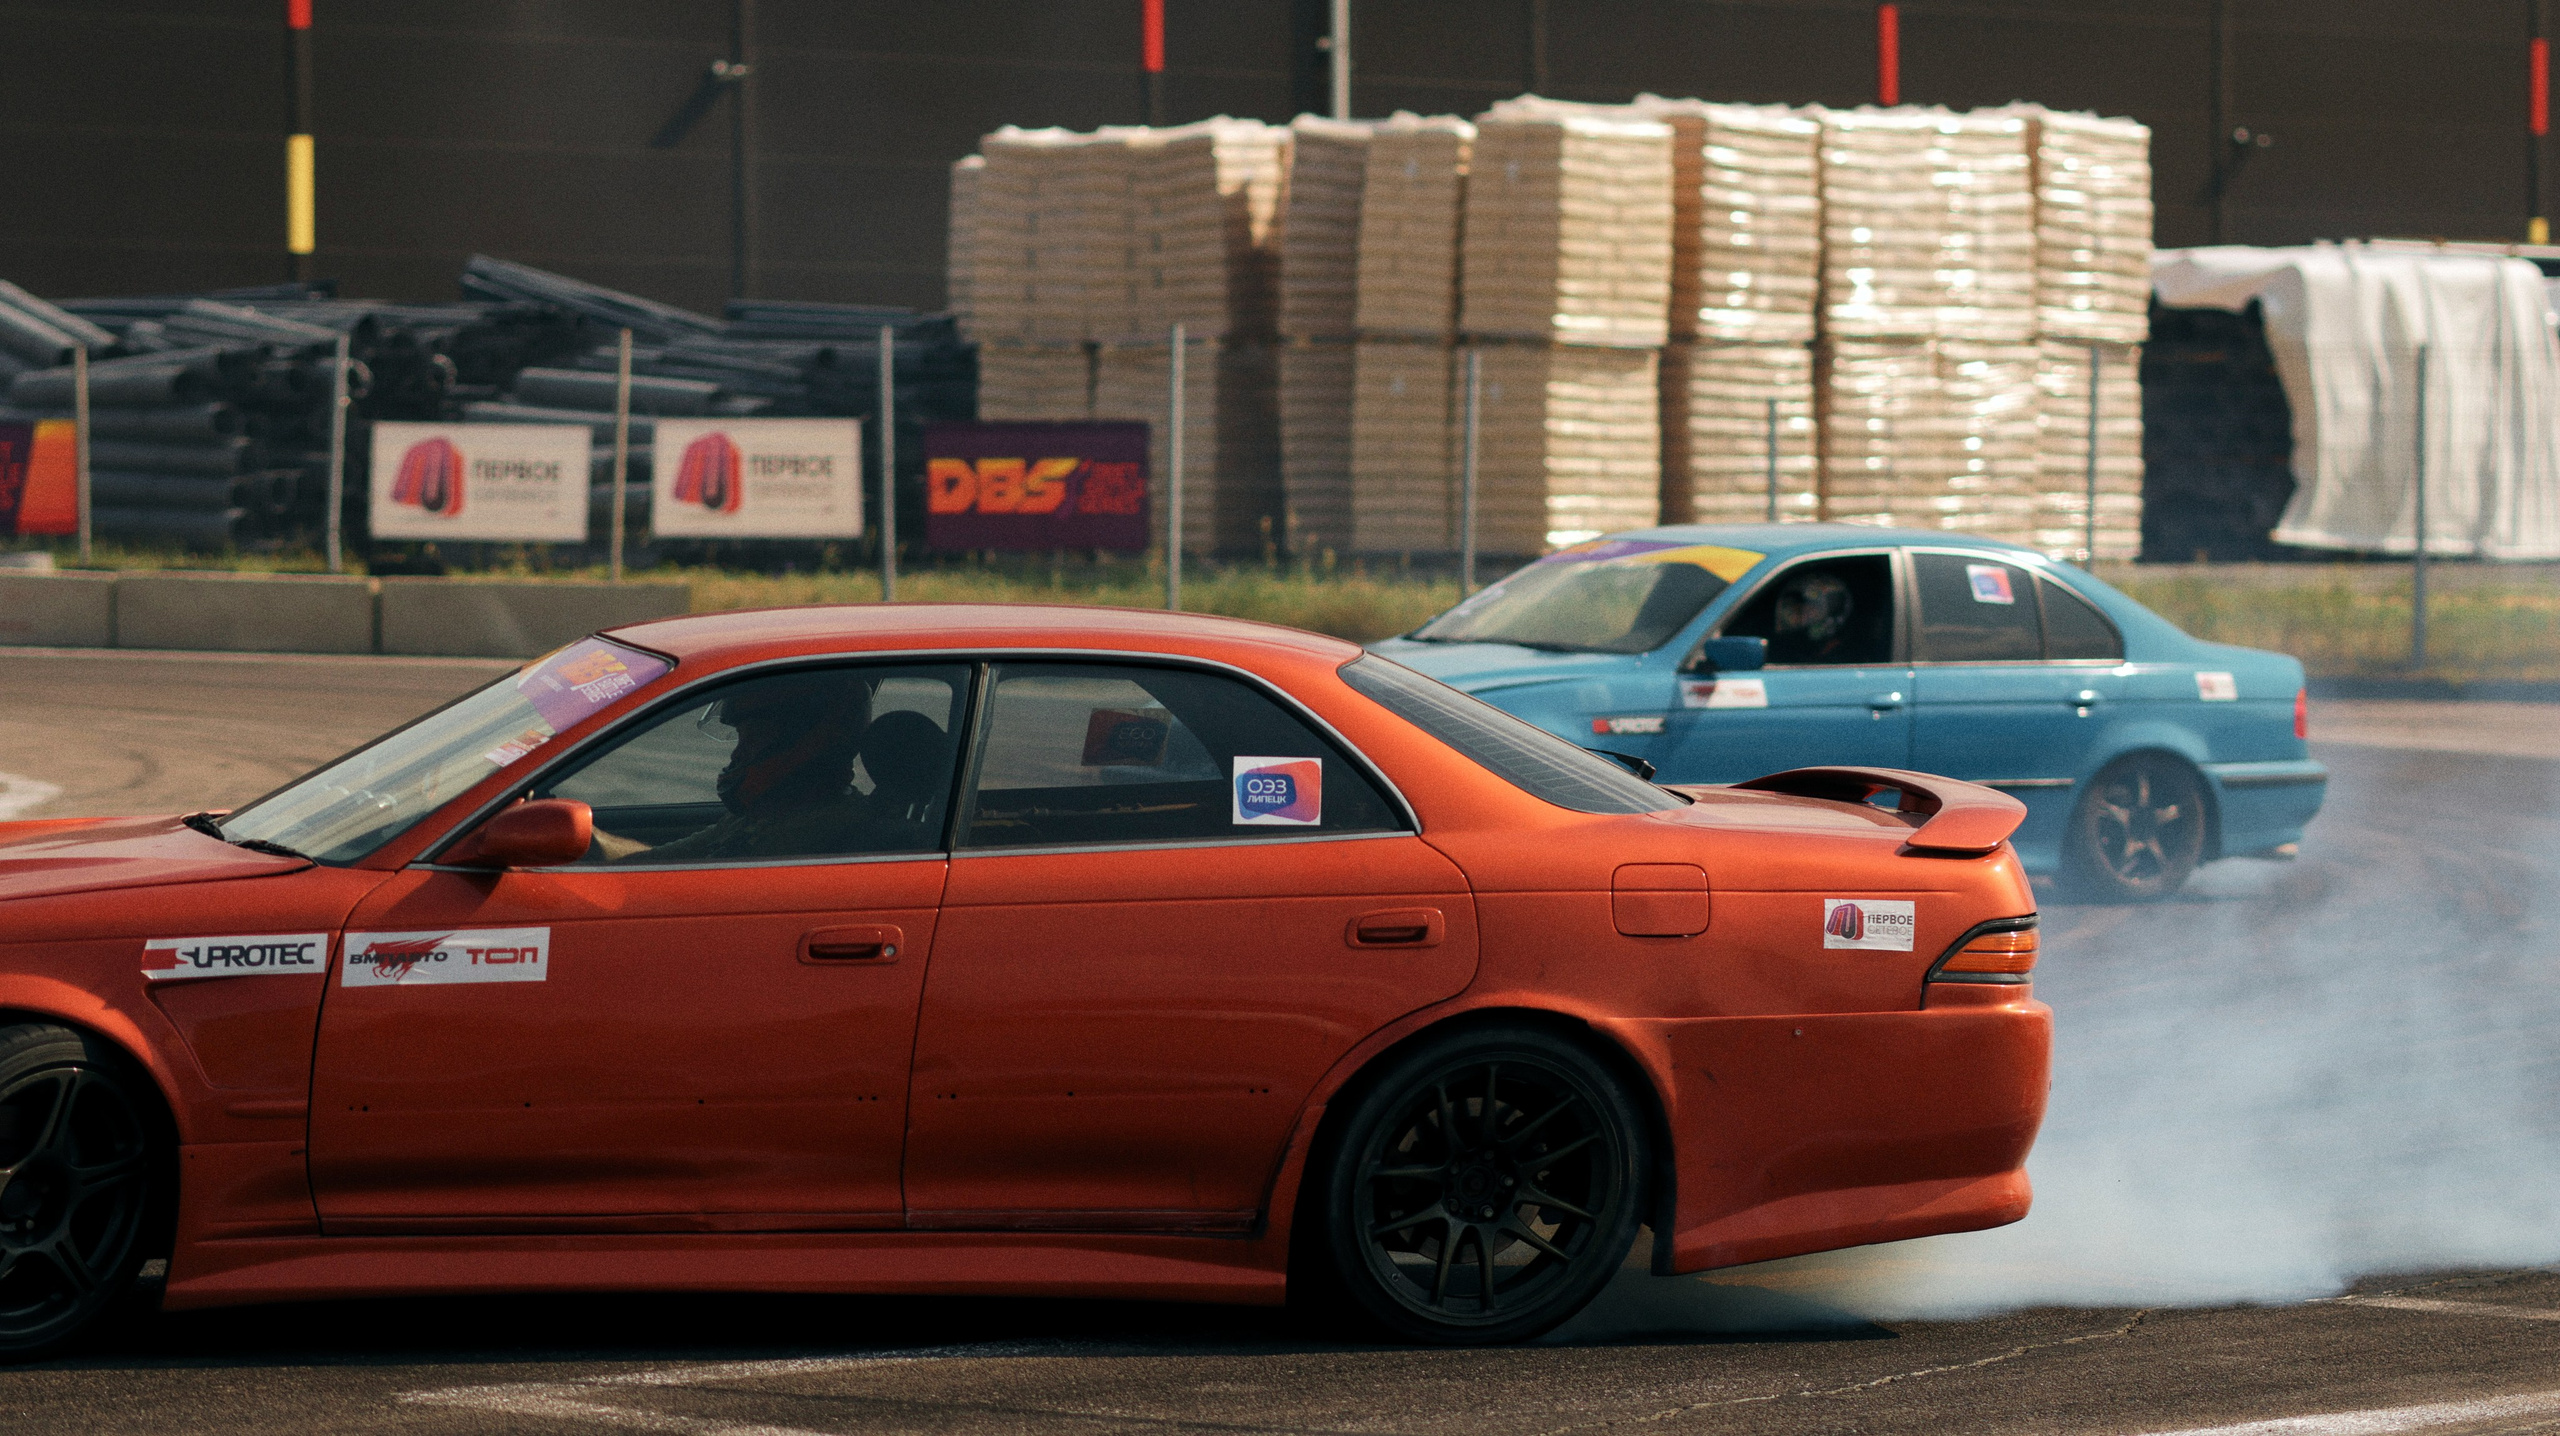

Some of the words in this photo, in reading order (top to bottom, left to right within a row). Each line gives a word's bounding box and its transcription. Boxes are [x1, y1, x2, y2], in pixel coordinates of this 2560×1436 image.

[927, 457, 1079, 515] DBS
[1247, 778, 1287, 794] ОЭЗ
[1247, 795, 1287, 804] ЛИПЕЦК
[1866, 914, 1913, 925] ПЕРВОЕ
[174, 942, 316, 969] SUPROTEC
